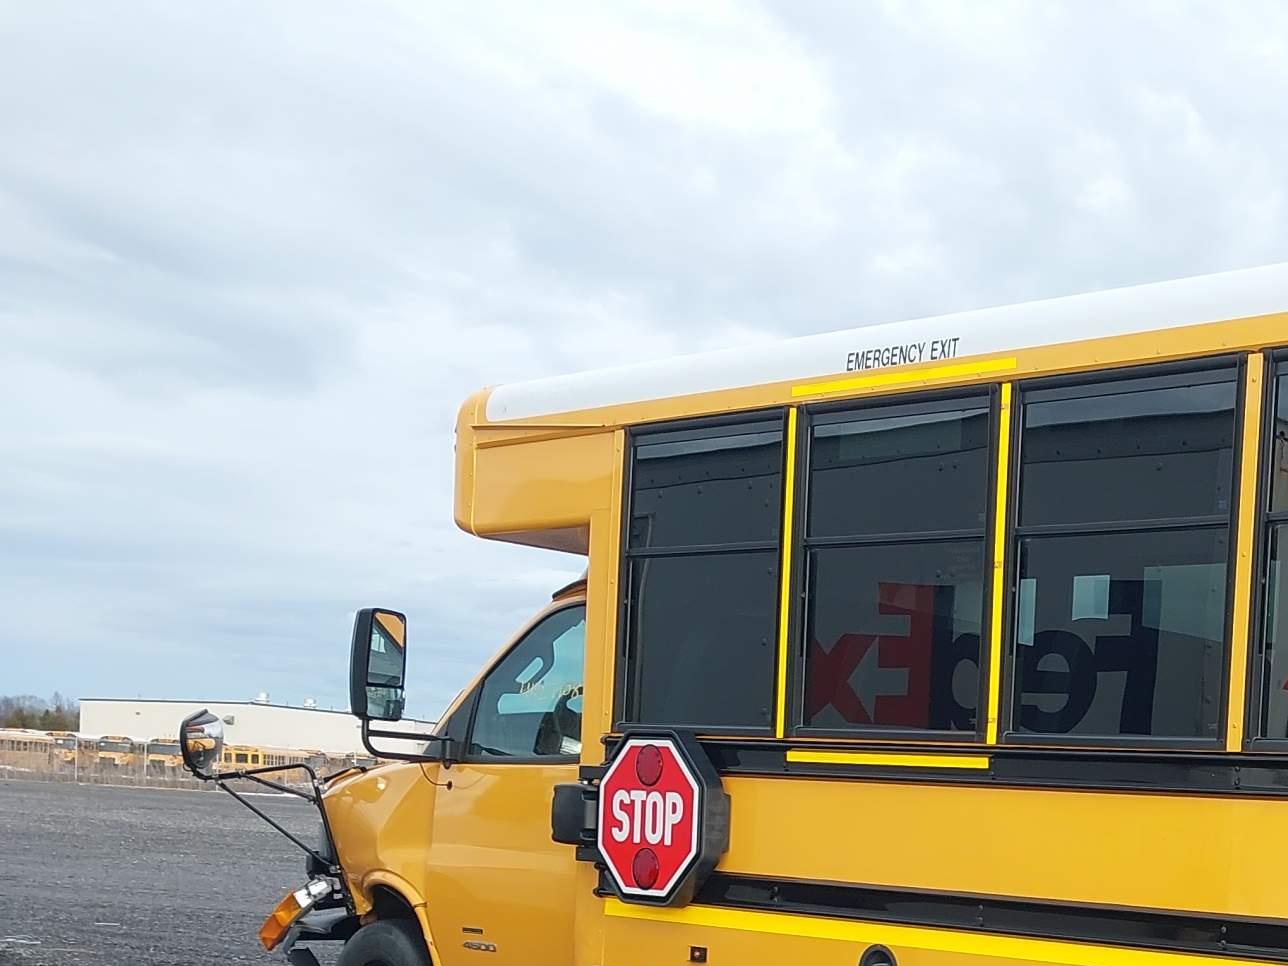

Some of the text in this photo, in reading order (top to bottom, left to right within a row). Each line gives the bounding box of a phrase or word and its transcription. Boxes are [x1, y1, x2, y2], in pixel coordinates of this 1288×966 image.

[846, 337, 960, 372] EMERGENCY EXIT
[611, 789, 684, 846] STOP
